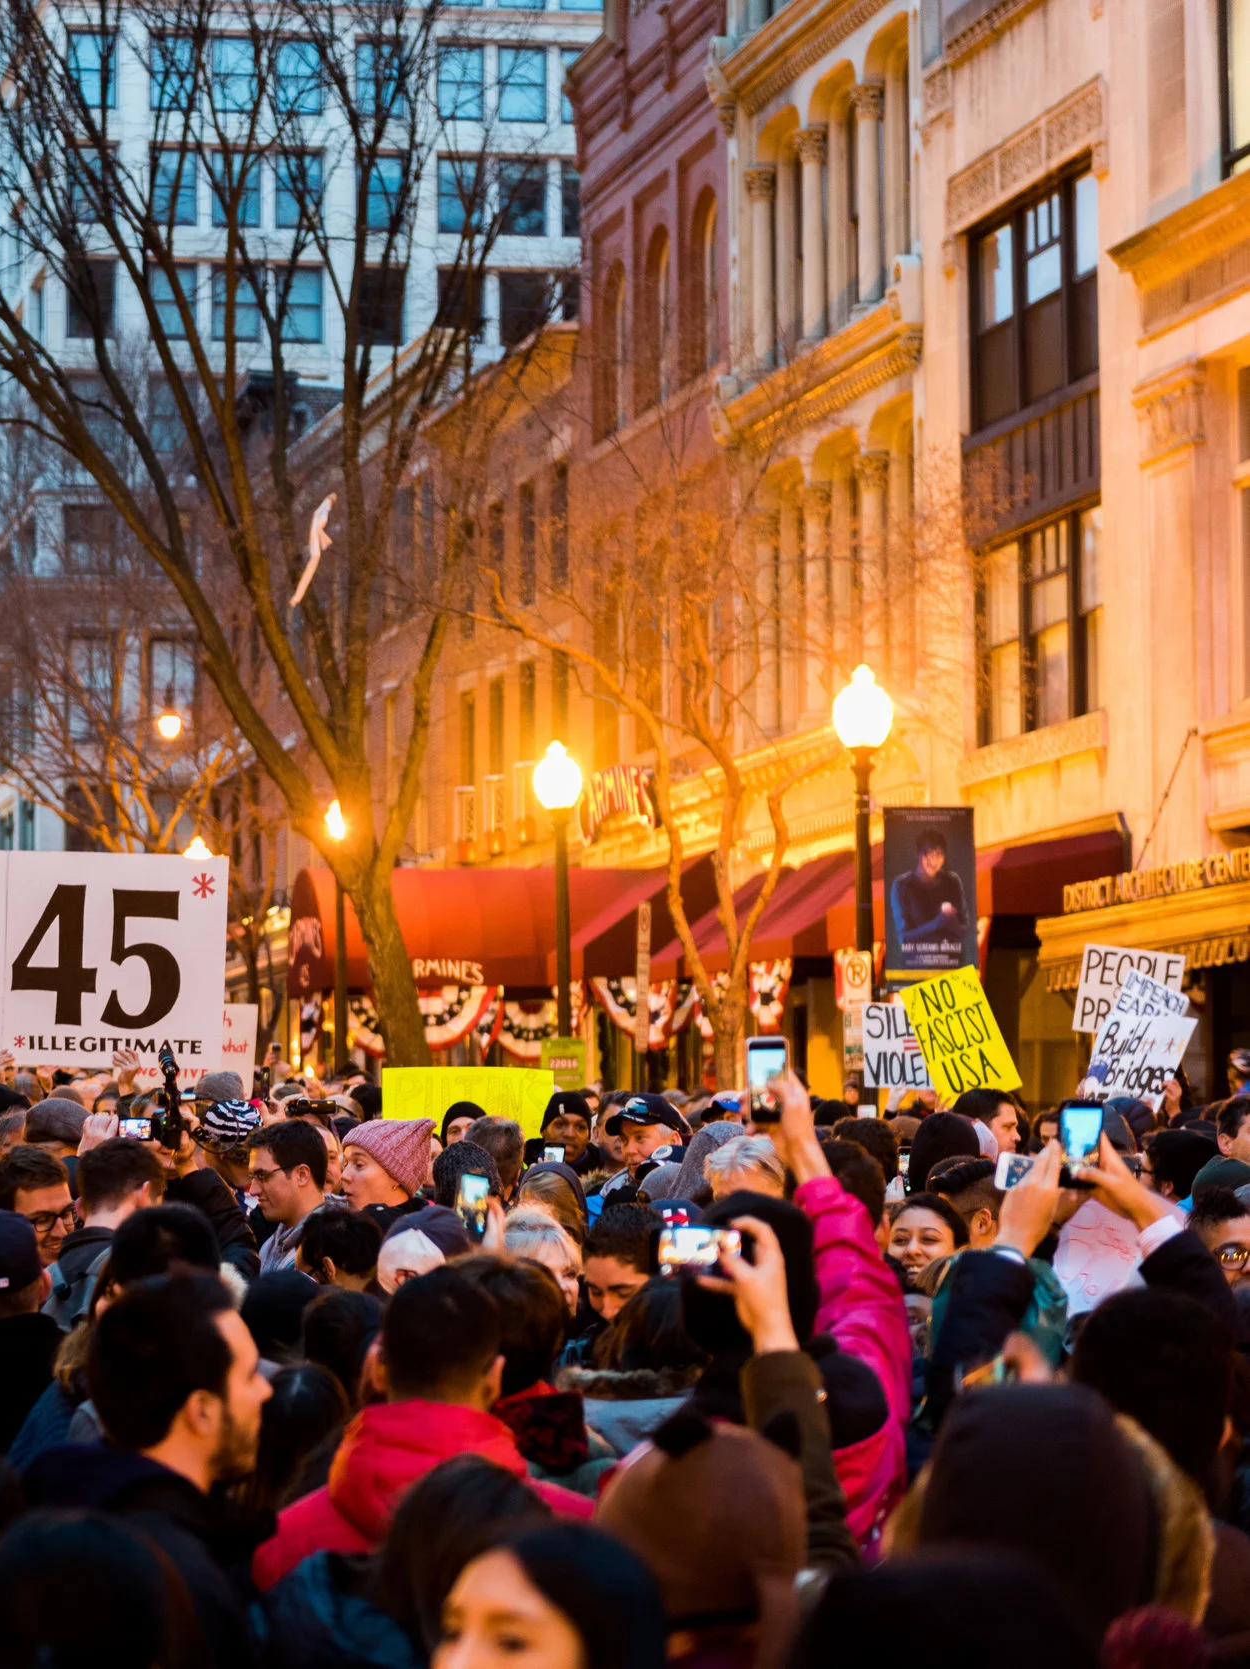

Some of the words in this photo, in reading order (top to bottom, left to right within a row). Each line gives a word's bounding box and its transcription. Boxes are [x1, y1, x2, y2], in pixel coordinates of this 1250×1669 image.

[1063, 875, 1113, 913] DISTRICT
[1113, 858, 1205, 903] ARCHITECTURE
[412, 958, 485, 985] RMINES
[919, 979, 956, 1017] NO
[915, 1002, 992, 1064] FASCIST
[1099, 1020, 1151, 1056] Build
[941, 1048, 1002, 1094] USA
